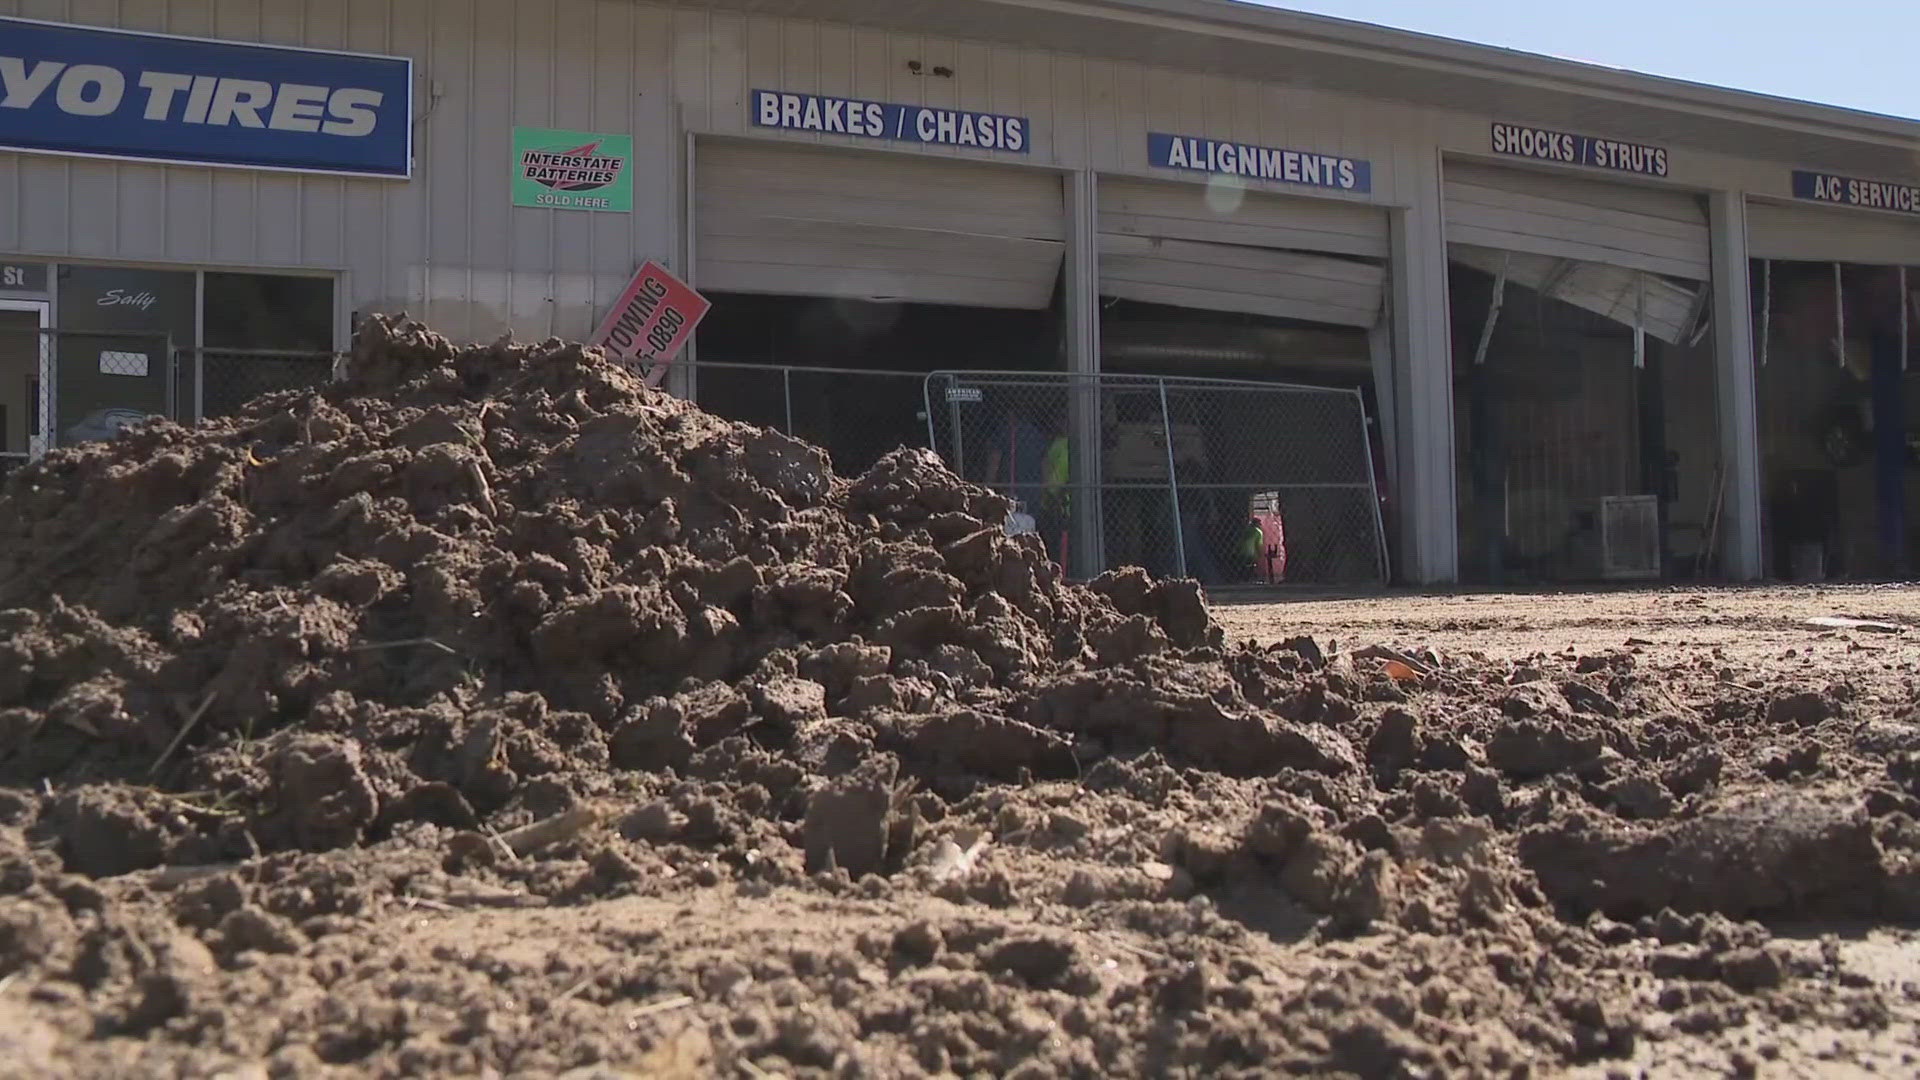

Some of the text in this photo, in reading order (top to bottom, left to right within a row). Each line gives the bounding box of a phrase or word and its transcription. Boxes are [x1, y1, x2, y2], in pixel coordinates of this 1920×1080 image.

[138, 71, 384, 137] TIRES
[759, 92, 1023, 150] BRAKES / CHASIS
[523, 152, 621, 170] INTERSTATE
[1168, 137, 1355, 189] ALIGNMENTS
[1493, 125, 1668, 177] SHOCKS / STRUTS
[526, 166, 614, 183] BATTERIES
[536, 194, 609, 208] SOLD HERE
[1814, 175, 1920, 212] A/C SERVICE
[3, 266, 24, 286] St
[97, 289, 156, 311] Sally
[602, 277, 668, 356] TOWING
